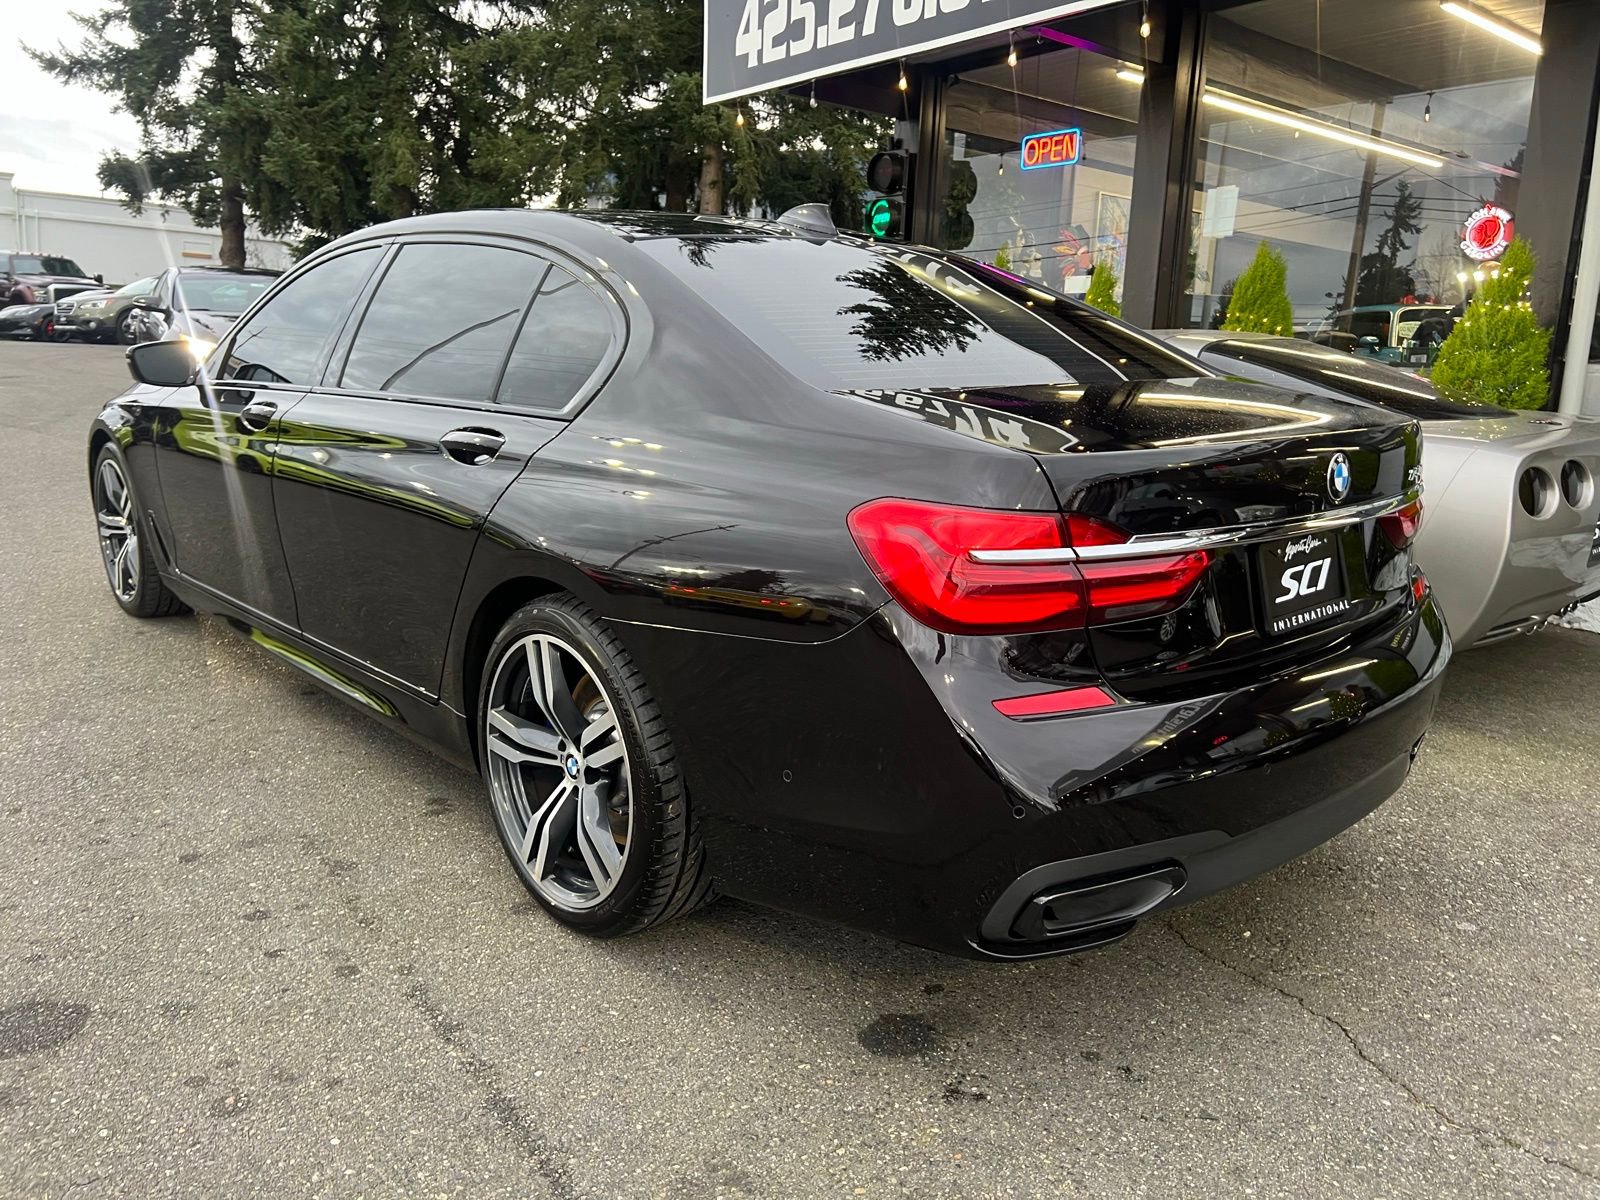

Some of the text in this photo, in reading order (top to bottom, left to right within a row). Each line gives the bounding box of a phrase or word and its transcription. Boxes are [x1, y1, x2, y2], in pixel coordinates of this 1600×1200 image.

[1024, 133, 1077, 165] OPEN
[1275, 557, 1332, 604] SCI
[1273, 600, 1350, 632] INTERNATIONAL
